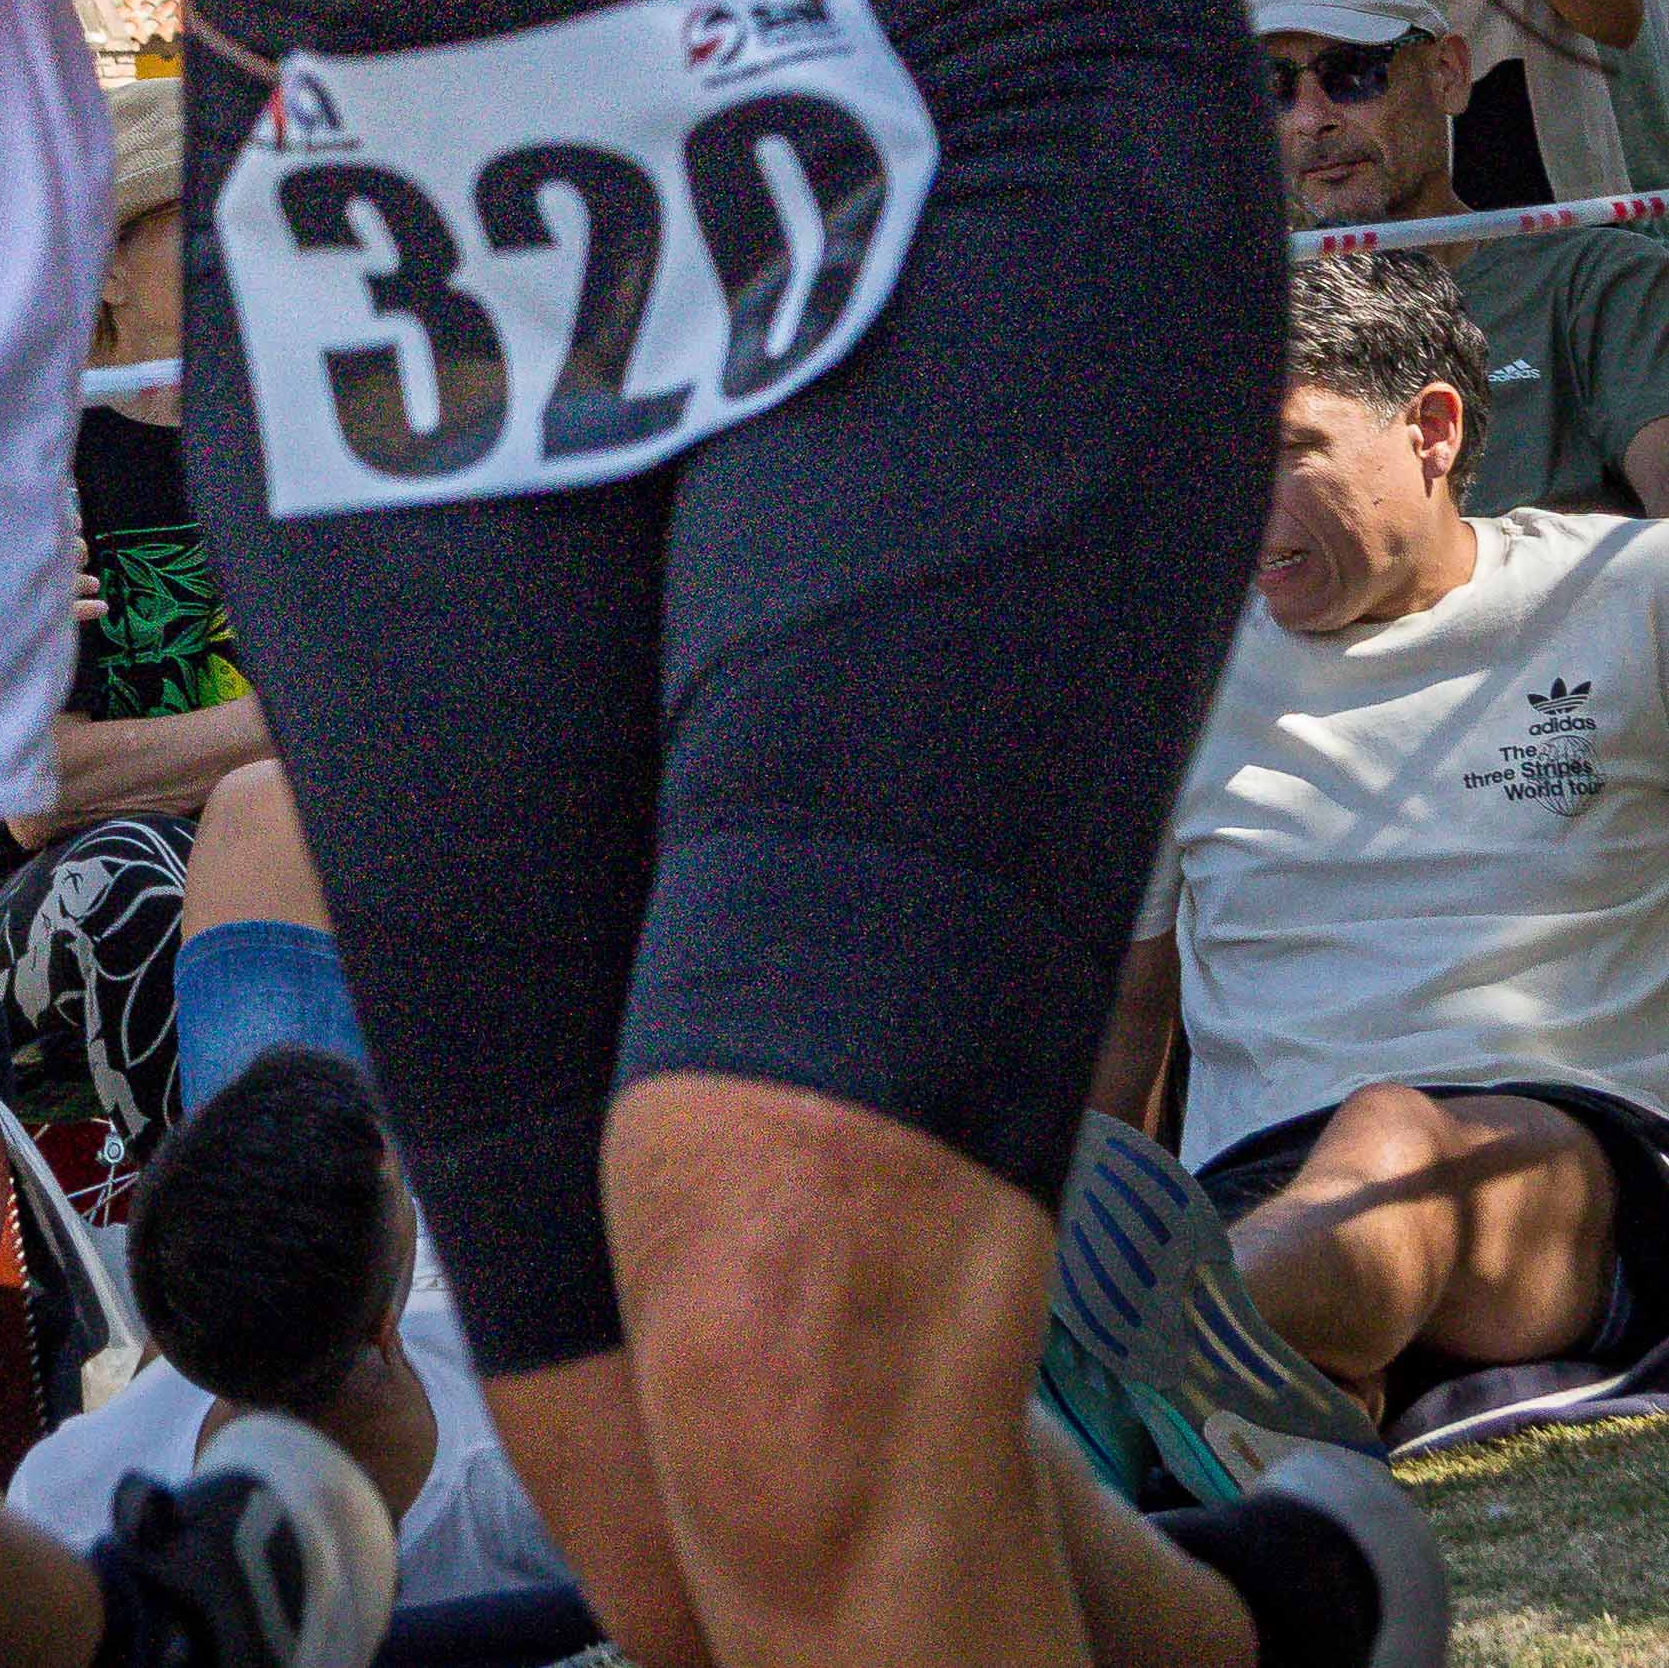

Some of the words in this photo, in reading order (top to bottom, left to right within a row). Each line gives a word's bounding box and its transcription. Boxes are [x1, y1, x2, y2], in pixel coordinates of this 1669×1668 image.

[278, 91, 889, 482] 320
[1529, 716, 1597, 736] adidas
[1500, 744, 1537, 762] The
[1463, 768, 1515, 790] three
[1521, 759, 1594, 779] Stripes
[1504, 780, 1564, 801] World
[1568, 778, 1605, 797] tour
